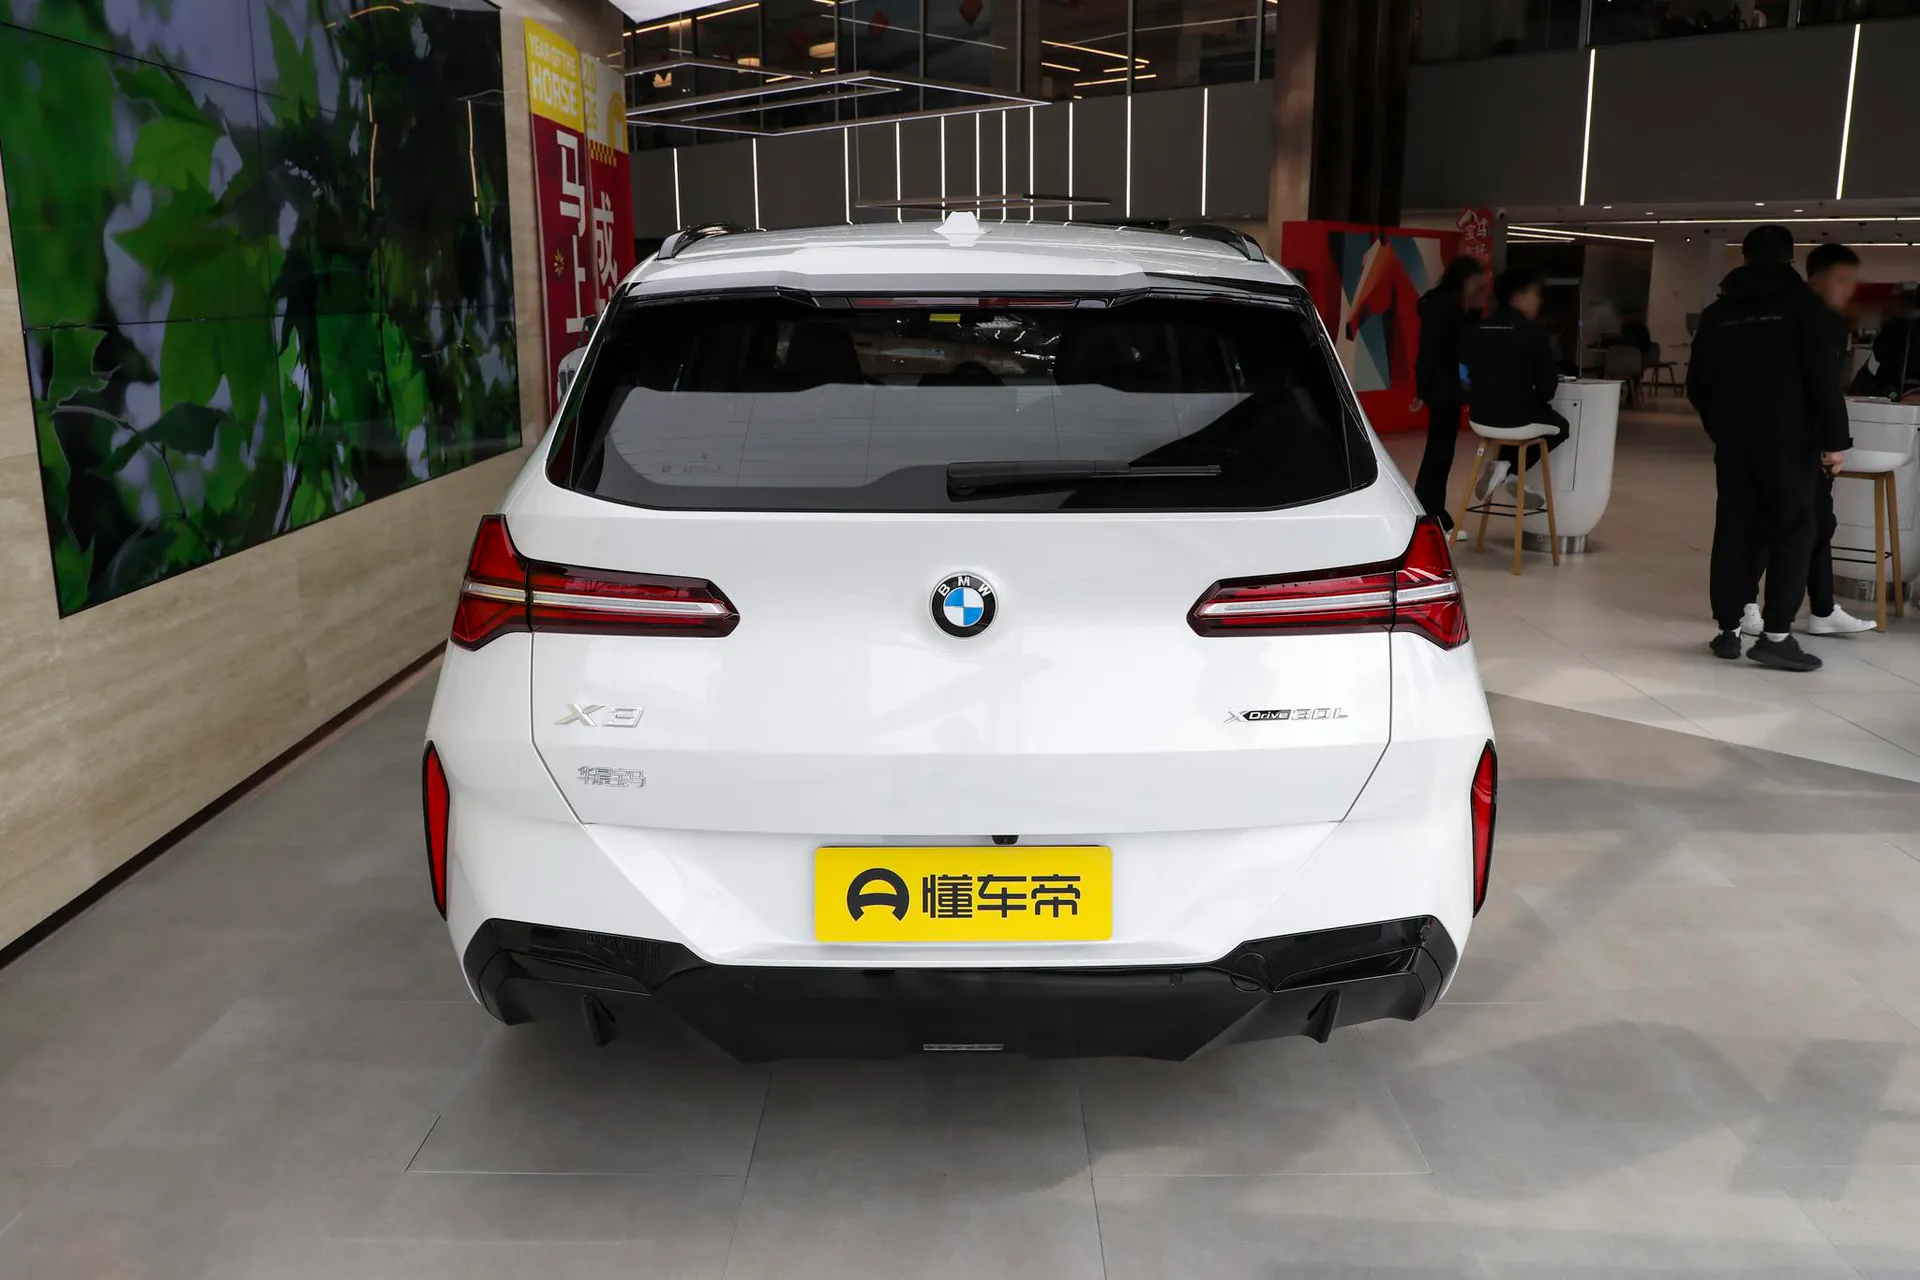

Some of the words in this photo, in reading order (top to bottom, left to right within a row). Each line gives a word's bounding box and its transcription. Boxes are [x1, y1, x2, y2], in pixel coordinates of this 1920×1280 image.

[528, 32, 550, 61] YEAR
[531, 60, 578, 117] HORSE
[556, 129, 590, 333] 马上
[937, 576, 992, 598] BMW
[554, 703, 644, 728] X3
[922, 873, 1081, 919] 懂车帝
